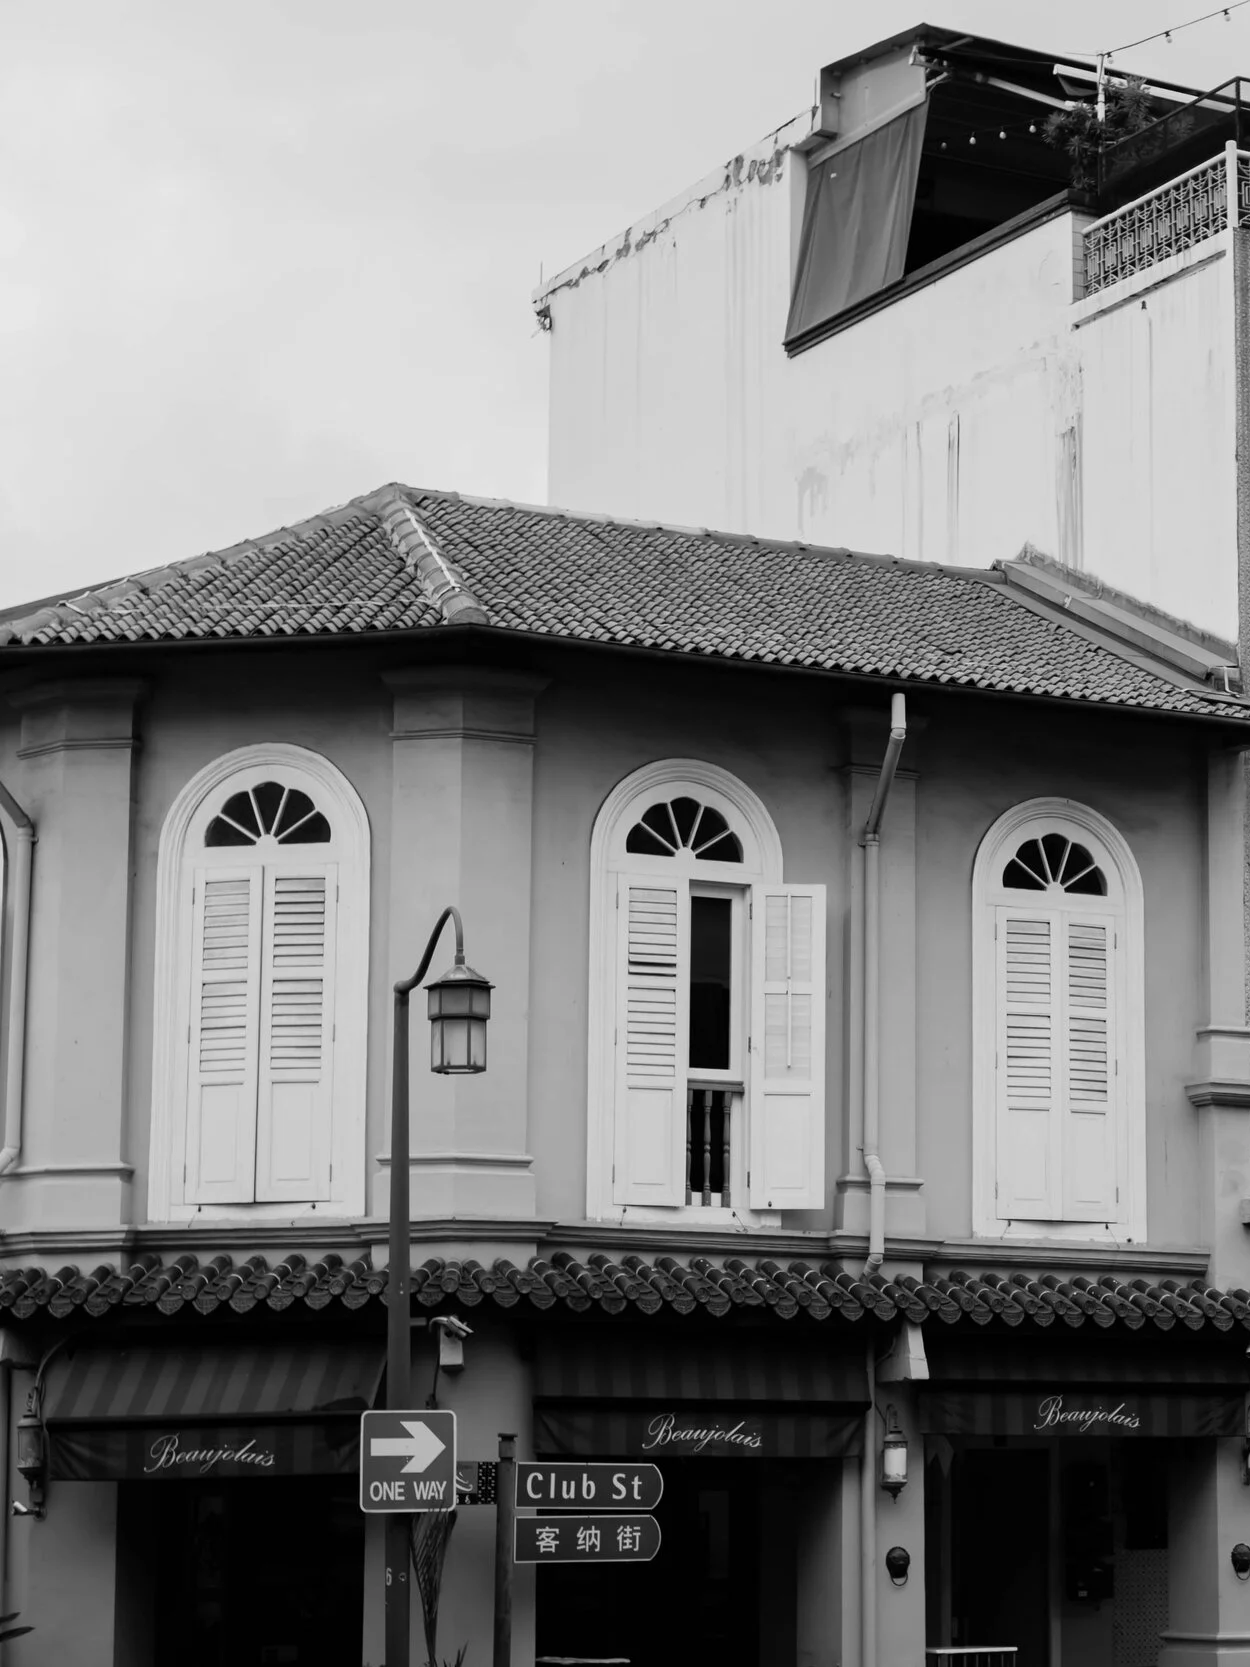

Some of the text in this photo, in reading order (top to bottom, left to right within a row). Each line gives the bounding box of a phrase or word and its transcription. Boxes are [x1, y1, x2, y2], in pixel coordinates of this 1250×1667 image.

[1034, 1395, 1141, 1432] Beaujolais
[641, 1412, 762, 1452] Beaujolais
[143, 1432, 276, 1474] Beaujolais
[370, 1481, 405, 1502] ONE
[413, 1481, 447, 1501] WAY
[526, 1472, 642, 1500] Club St
[535, 1526, 642, 1553] 客纳街
[386, 1567, 392, 1586] 6
